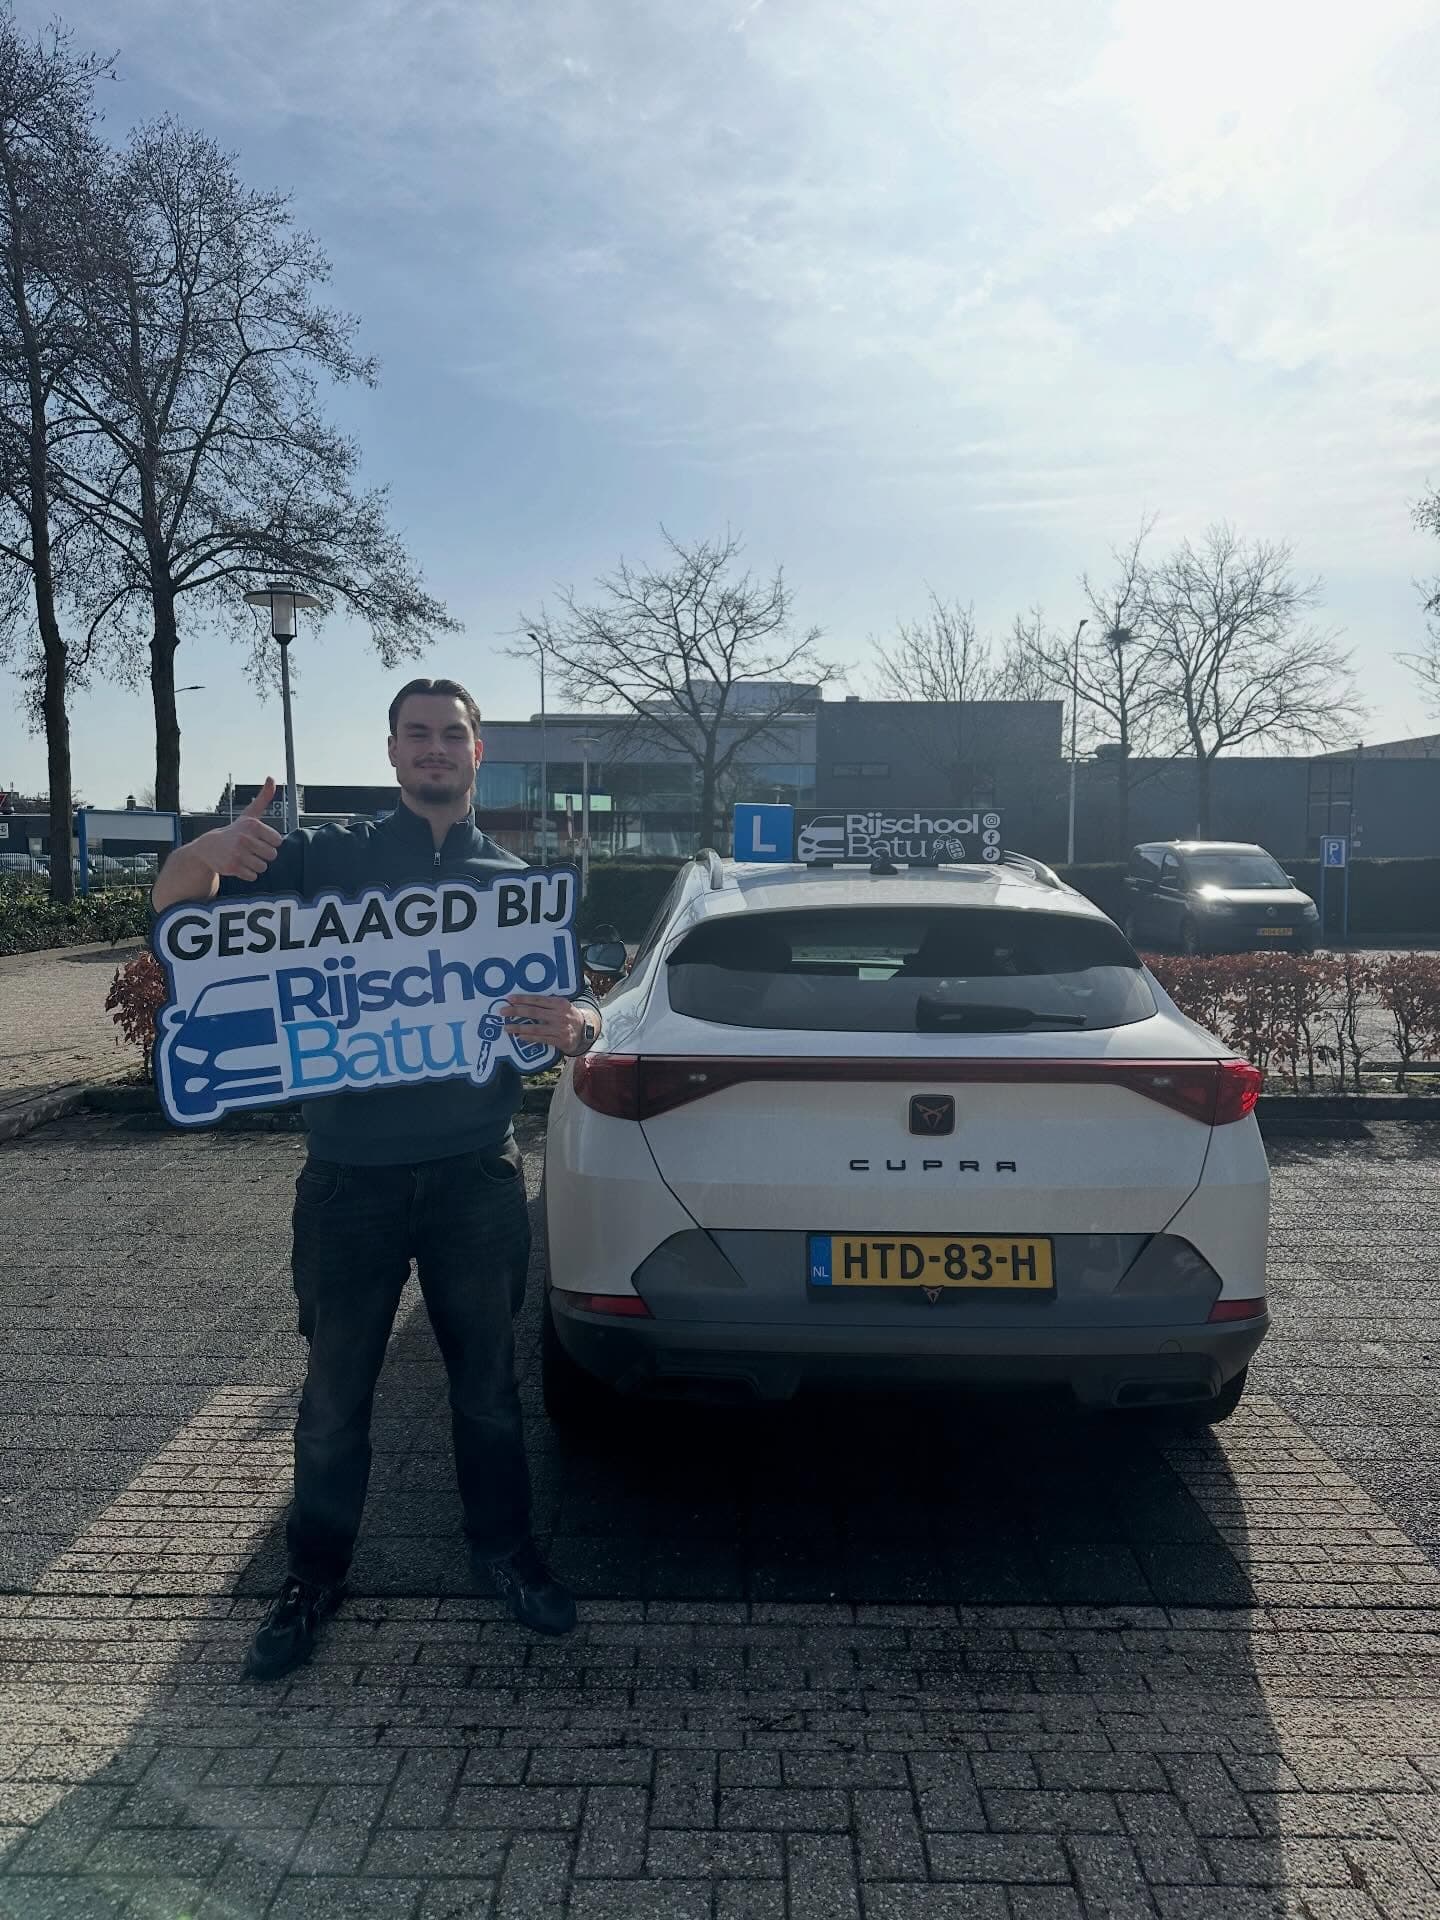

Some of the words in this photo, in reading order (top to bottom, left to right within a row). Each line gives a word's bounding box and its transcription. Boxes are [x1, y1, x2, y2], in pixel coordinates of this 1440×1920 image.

[752, 815, 776, 852] L
[846, 812, 979, 838] Rijschool
[847, 833, 928, 858] Batu
[1329, 842, 1340, 855] P
[167, 889, 477, 961] GESLAAGD
[497, 878, 568, 928] BIJ
[274, 935, 570, 1030] Rijschool
[279, 1017, 471, 1090] Batu
[849, 1159, 1017, 1172] CUPRA
[812, 1265, 830, 1278] NL
[843, 1242, 1037, 1282] HTD-83-H
